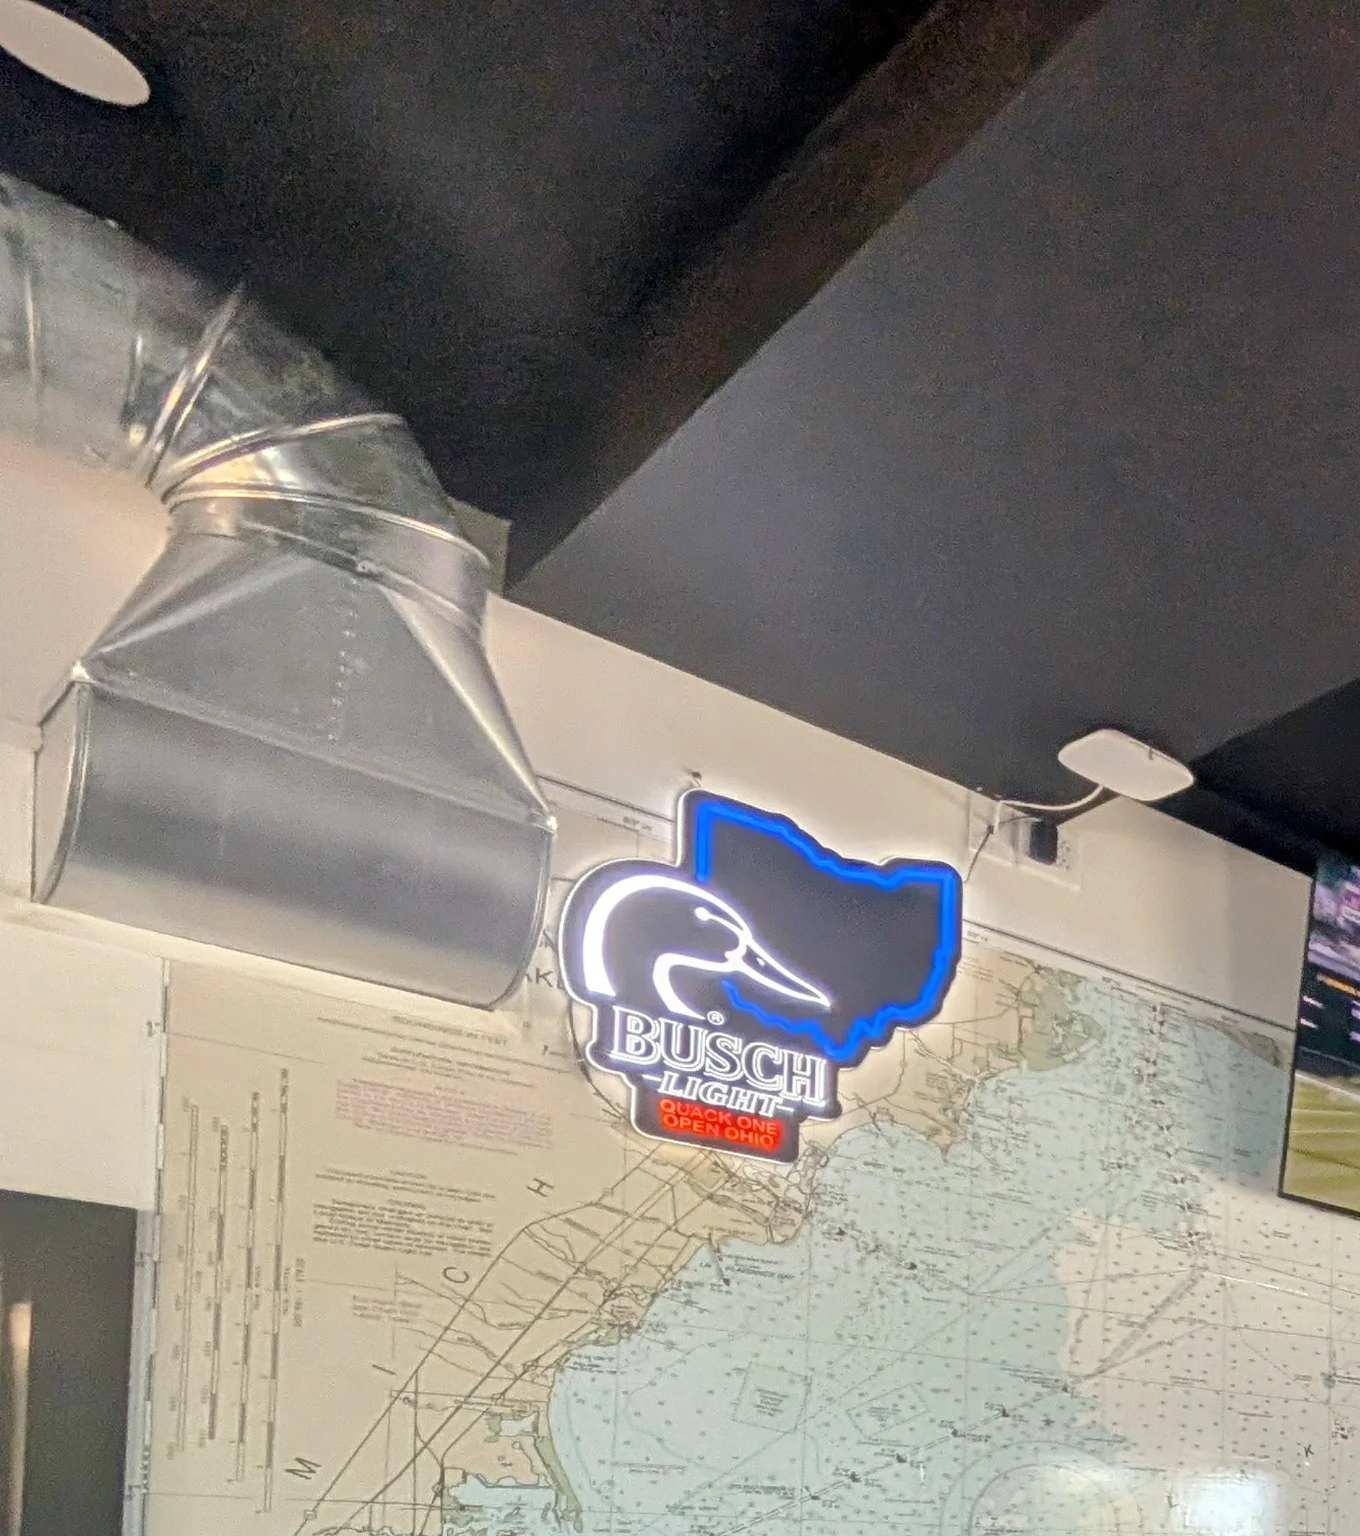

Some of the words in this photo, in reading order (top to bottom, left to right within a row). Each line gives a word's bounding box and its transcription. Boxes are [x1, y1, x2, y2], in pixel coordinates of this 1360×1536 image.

[608, 1006, 828, 1105] BUSCH
[657, 1071, 783, 1117] LIGHT
[660, 1099, 731, 1124] QUACK
[737, 1116, 777, 1135] ONE
[663, 1113, 719, 1137] OPEN
[724, 1127, 775, 1149] OHIO
